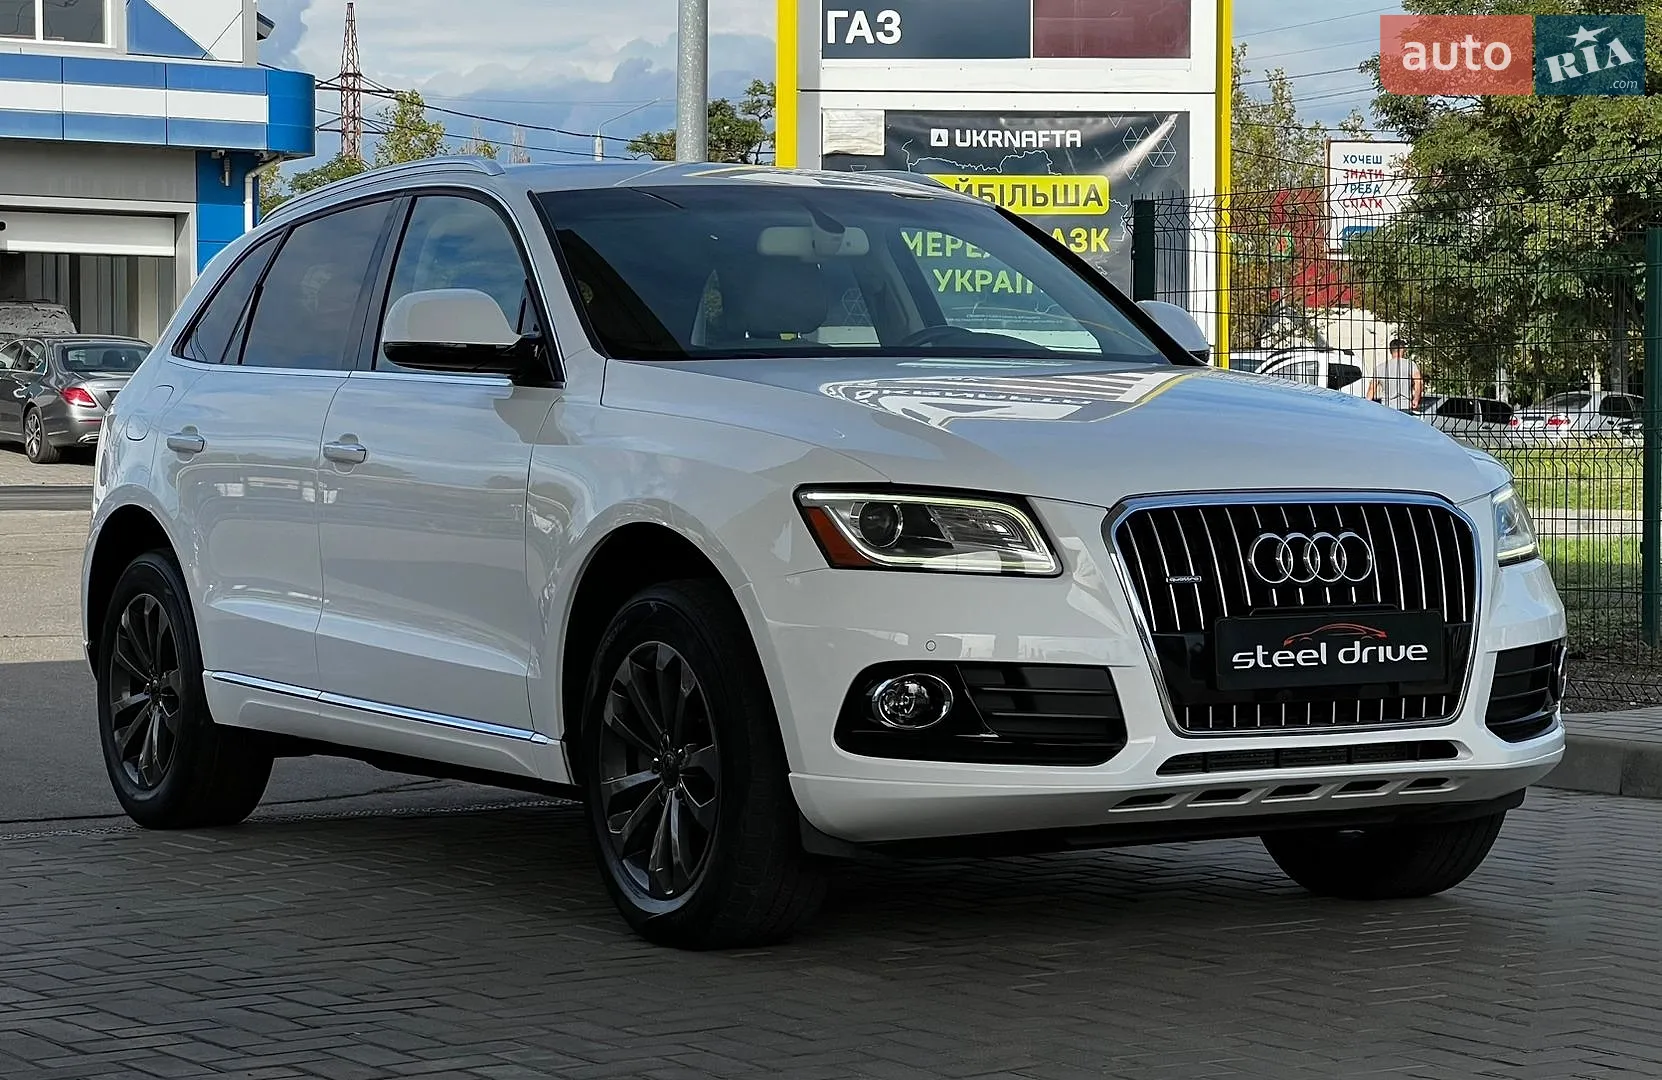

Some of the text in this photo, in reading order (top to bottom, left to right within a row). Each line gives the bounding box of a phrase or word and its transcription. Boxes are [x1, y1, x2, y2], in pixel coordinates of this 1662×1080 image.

[827, 10, 902, 44] ГАЗ
[955, 129, 1082, 148] UKRNAFTA
[1343, 155, 1382, 164] ХОЧЕШ
[1343, 168, 1384, 179] ЗНАТИ
[901, 231, 991, 258] МЕРЕ
[1232, 641, 1428, 669] steel drive
